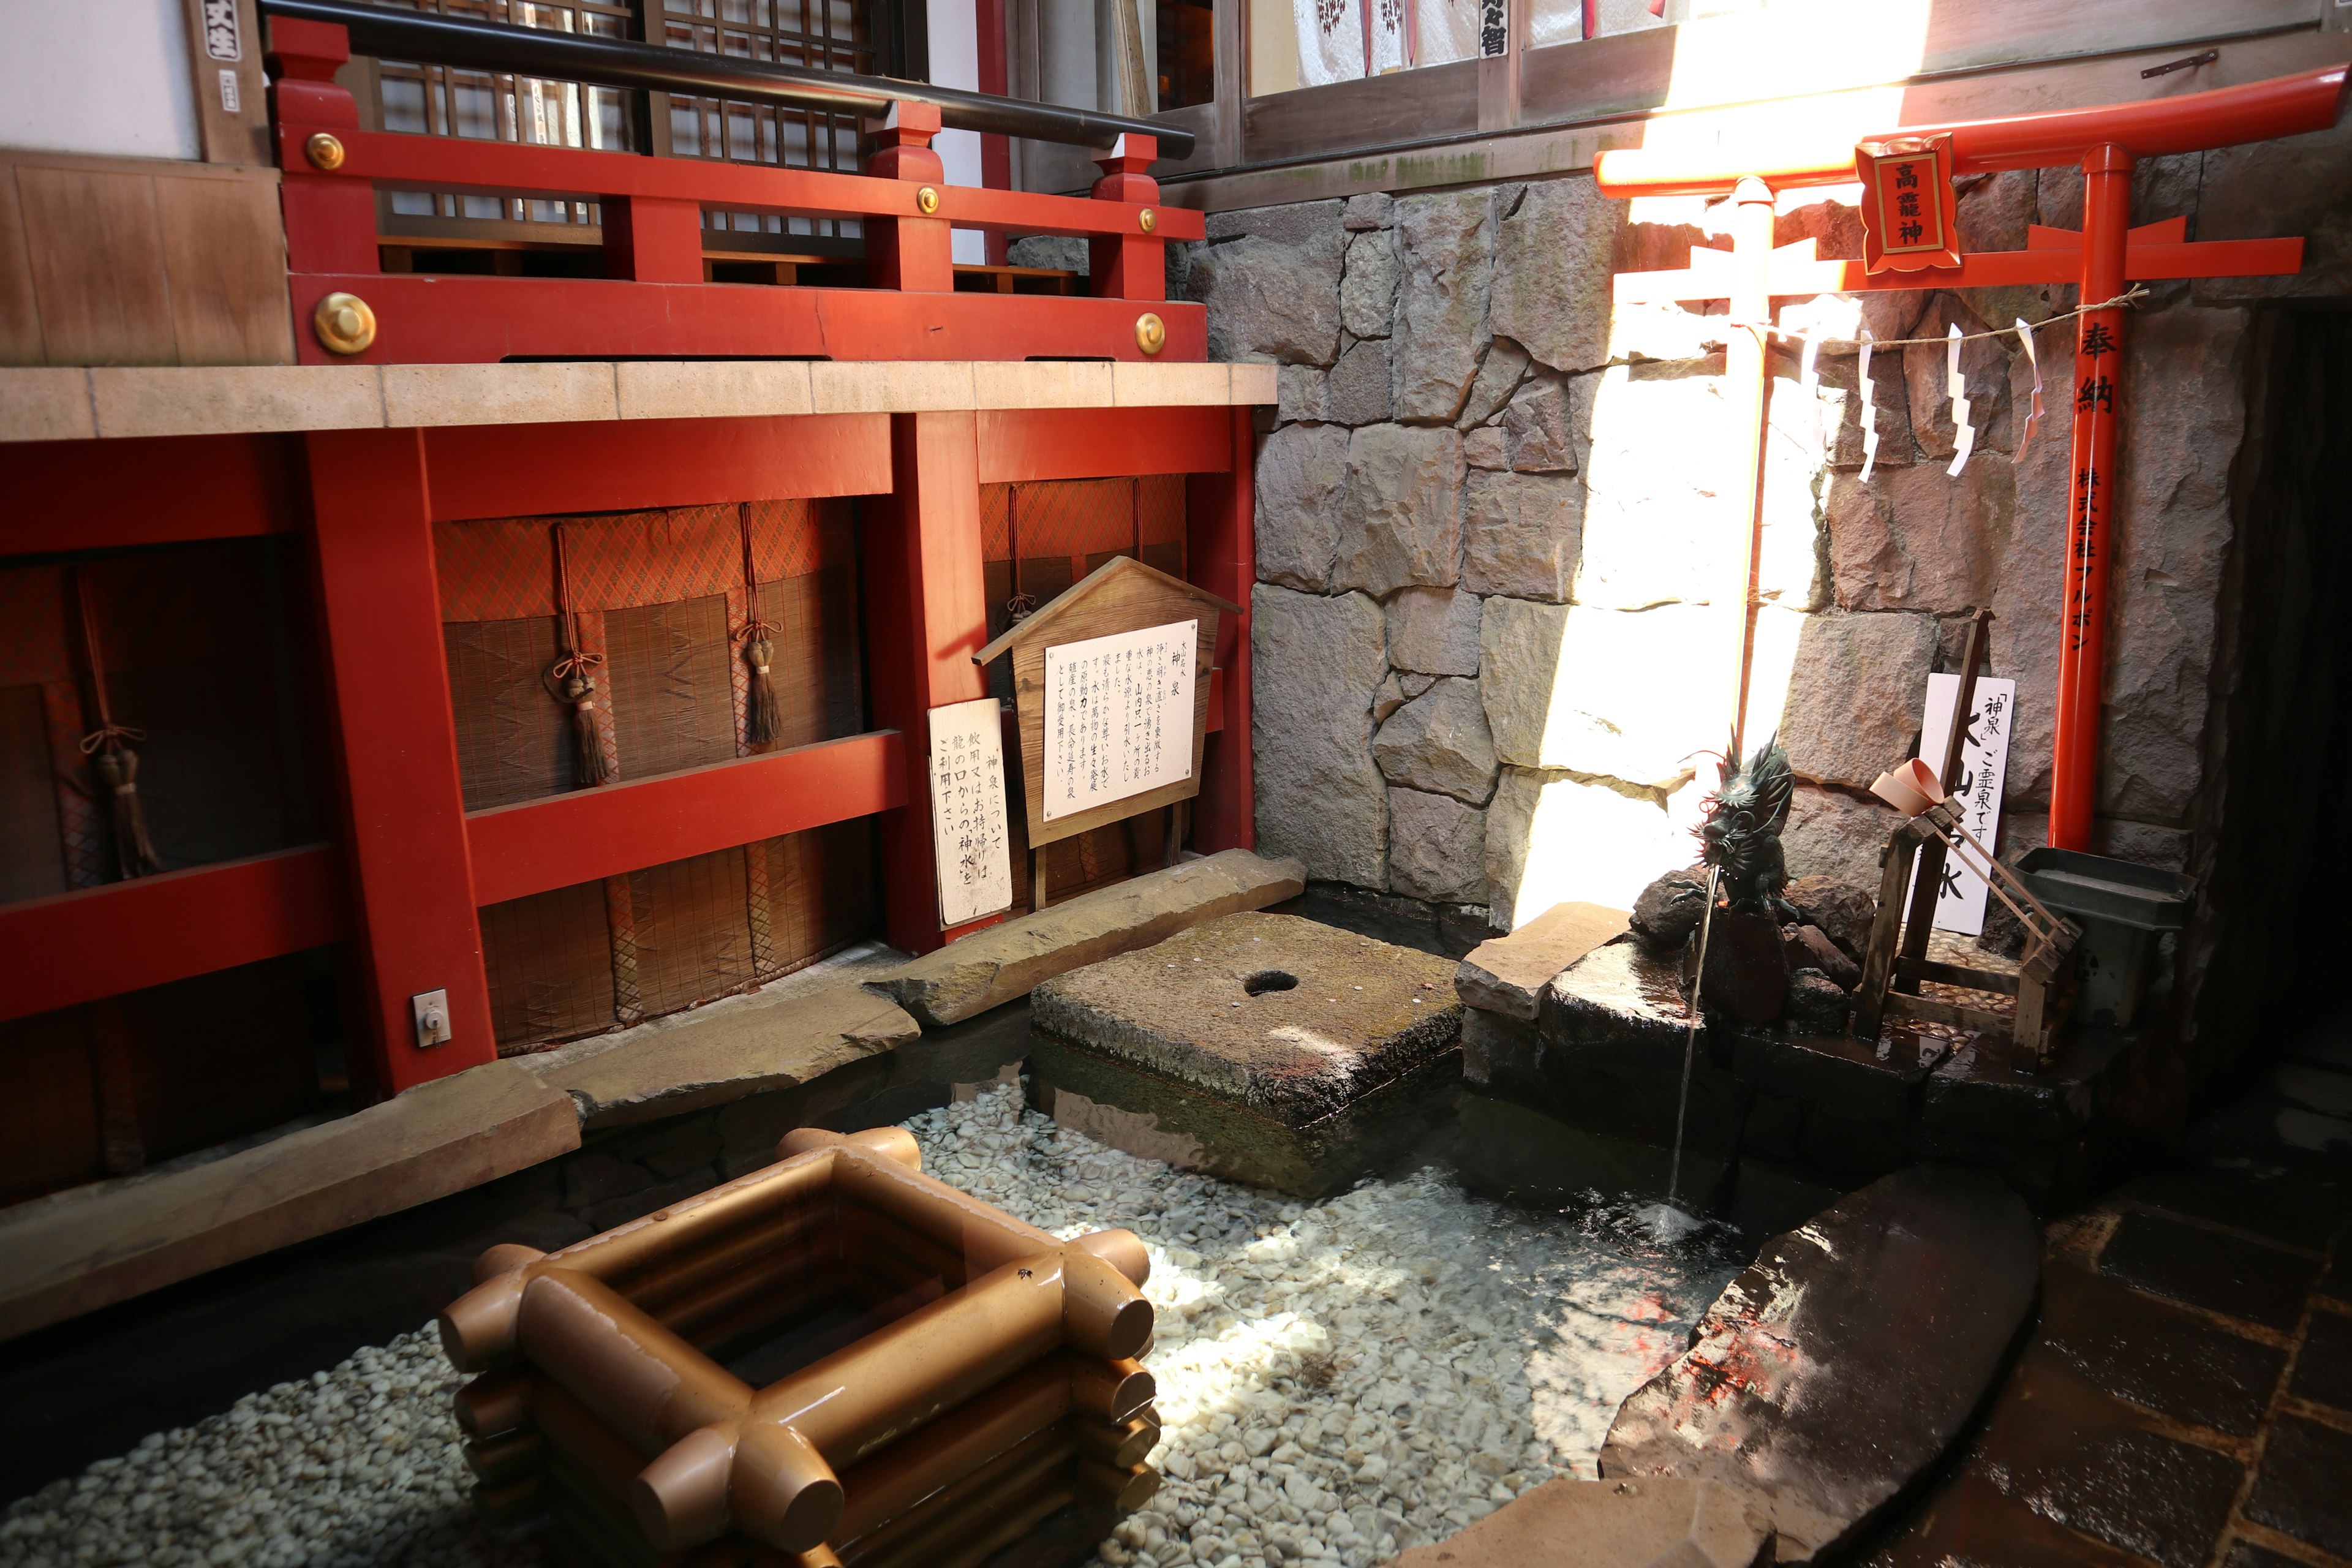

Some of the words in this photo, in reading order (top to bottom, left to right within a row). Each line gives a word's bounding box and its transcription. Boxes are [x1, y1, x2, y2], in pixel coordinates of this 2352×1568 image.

[2077, 322, 2117, 415] 奉納
[2071, 468, 2101, 651] 株式会社フルポン
[1079, 660, 1088, 780] の原動力であります。
[1101, 654, 1110, 789] 最も清らかな尊いお水で
[1123, 649, 1133, 782] 重な水源より引水いたし
[1144, 646, 1153, 777] 神の恵の泉で湧き出るお
[938, 739, 954, 835] ご利用下さい
[968, 732, 987, 879] 飲用又はお持帰りは
[986, 755, 1001, 849] 神泉について
